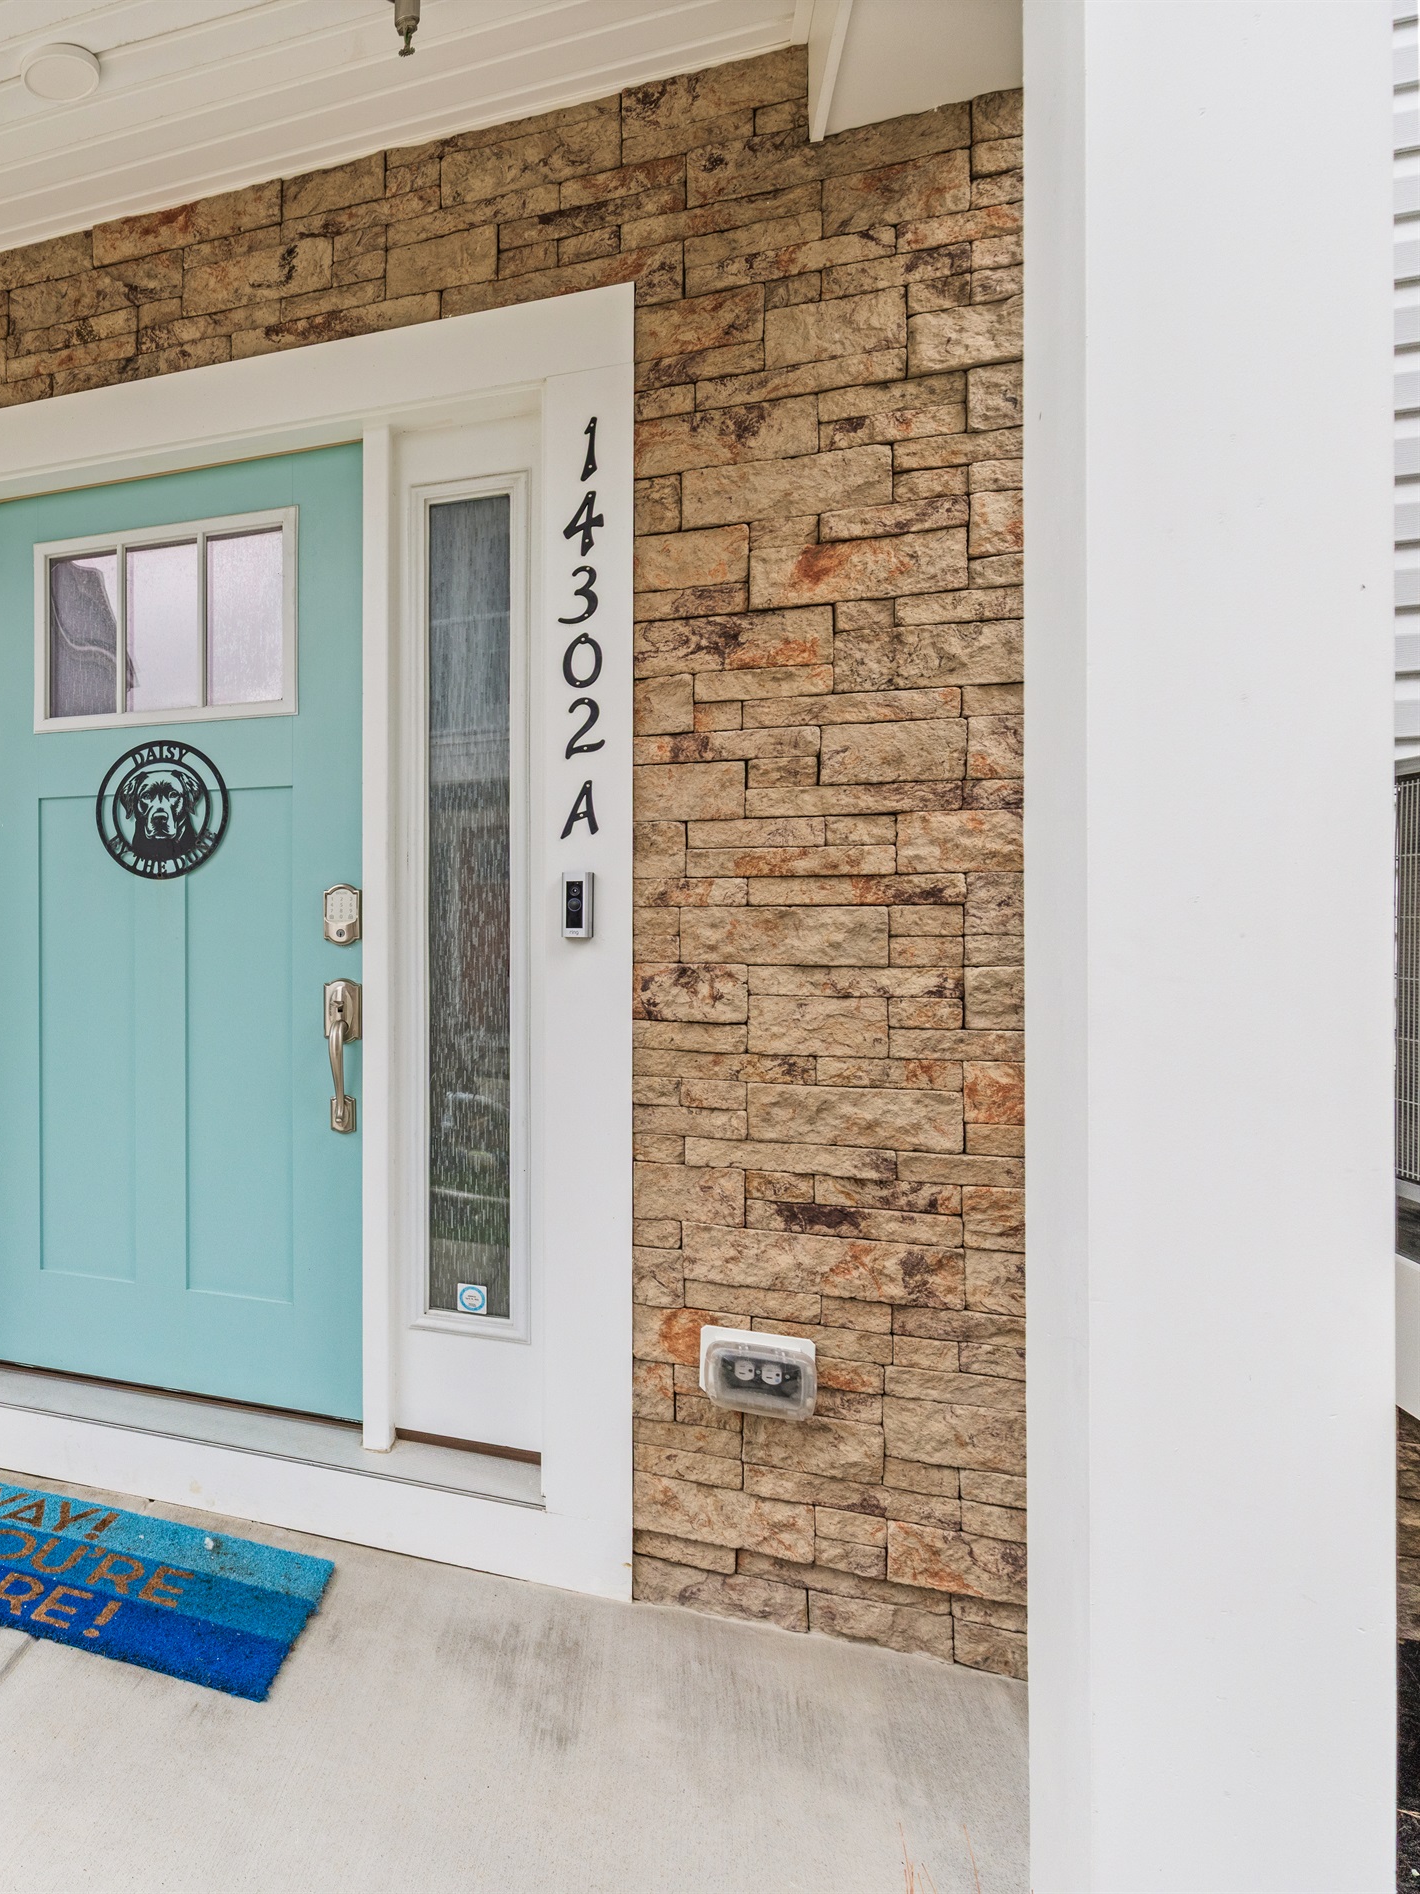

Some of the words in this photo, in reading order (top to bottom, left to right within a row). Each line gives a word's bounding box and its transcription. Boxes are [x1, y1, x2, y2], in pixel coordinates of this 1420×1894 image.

[131, 744, 189, 767] DAISY
[108, 834, 132, 859] BY
[132, 855, 168, 876] THE
